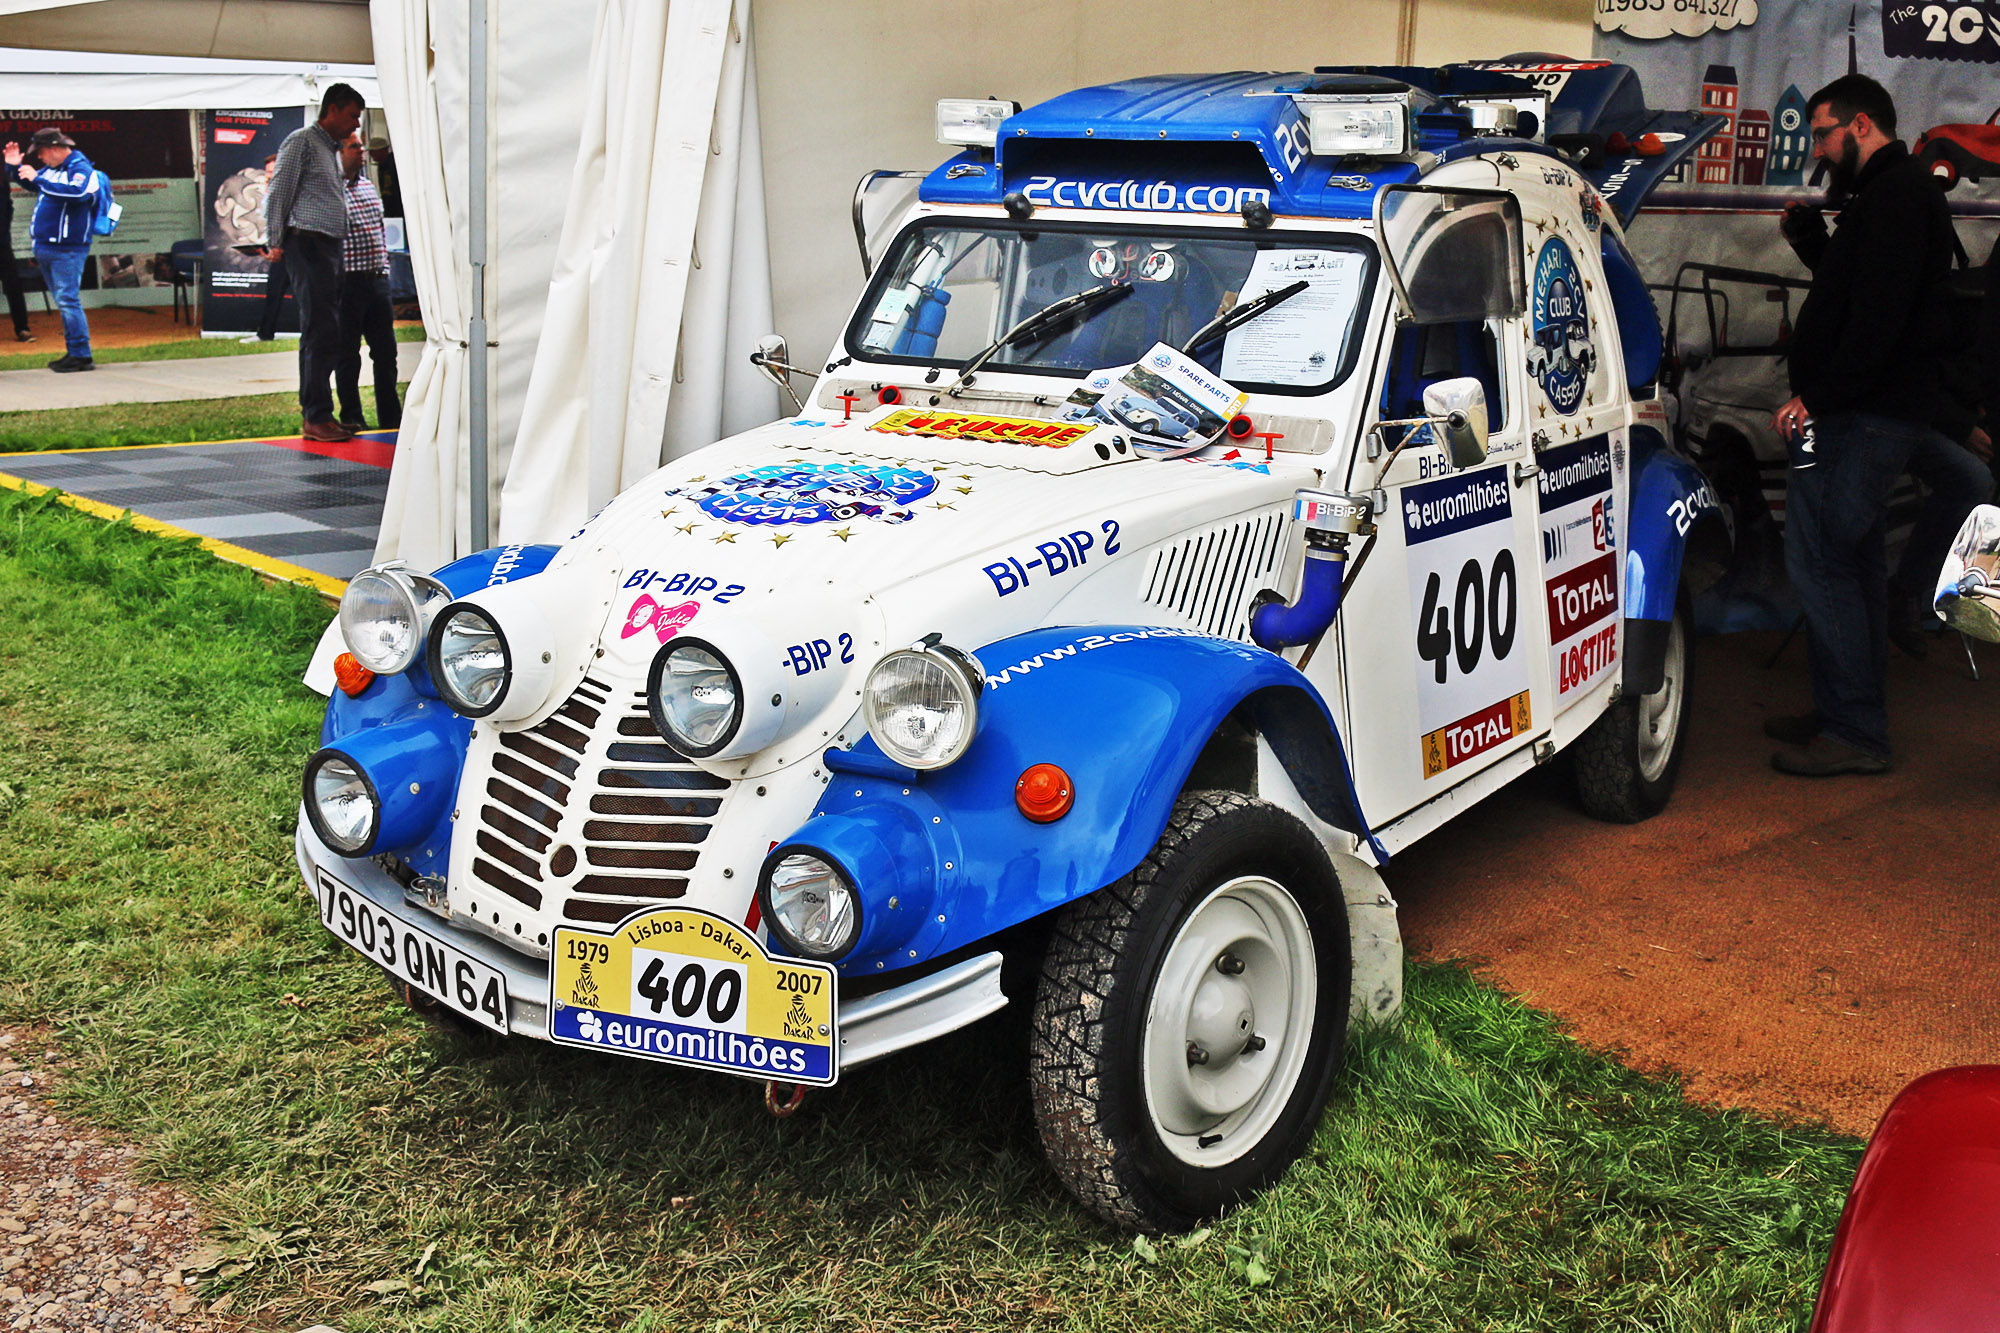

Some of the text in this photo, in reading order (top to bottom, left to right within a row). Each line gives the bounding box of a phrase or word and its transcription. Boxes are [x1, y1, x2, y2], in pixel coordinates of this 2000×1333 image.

[1674, 0, 1738, 17] 841327
[1889, 5, 2000, 47] The 2C
[9, 110, 74, 120] GLOBAL
[1536, 248, 1585, 322] MEHARI 2CV
[1550, 297, 1572, 318] CLUB
[1178, 365, 1231, 403] SPARE PARTS
[1550, 374, 1580, 406] CASSIS
[1226, 400, 1242, 416] 2017
[1549, 451, 1610, 492] euromilhões
[1356, 506, 1367, 520] 2
[1422, 480, 1508, 527] euromilhões
[1595, 513, 1605, 546] 2
[1606, 508, 1615, 541] 3
[982, 520, 1121, 597] BI-BIP 2
[622, 569, 746, 604] BI-BIP 2
[1552, 574, 1615, 626] TOTAL
[656, 611, 691, 634] Julie
[1417, 548, 1517, 684] 400
[838, 632, 856, 665] 2
[1560, 623, 1617, 695] LOCTITE
[1446, 713, 1511, 759] TOTAL
[320, 876, 504, 1026] 7903 QN 64
[567, 939, 610, 964] 1979
[627, 918, 684, 945] Lisboa
[700, 921, 753, 962] Dakar
[637, 957, 742, 1024] 400
[776, 970, 823, 996] 2007
[607, 1022, 807, 1072] euromilhões
